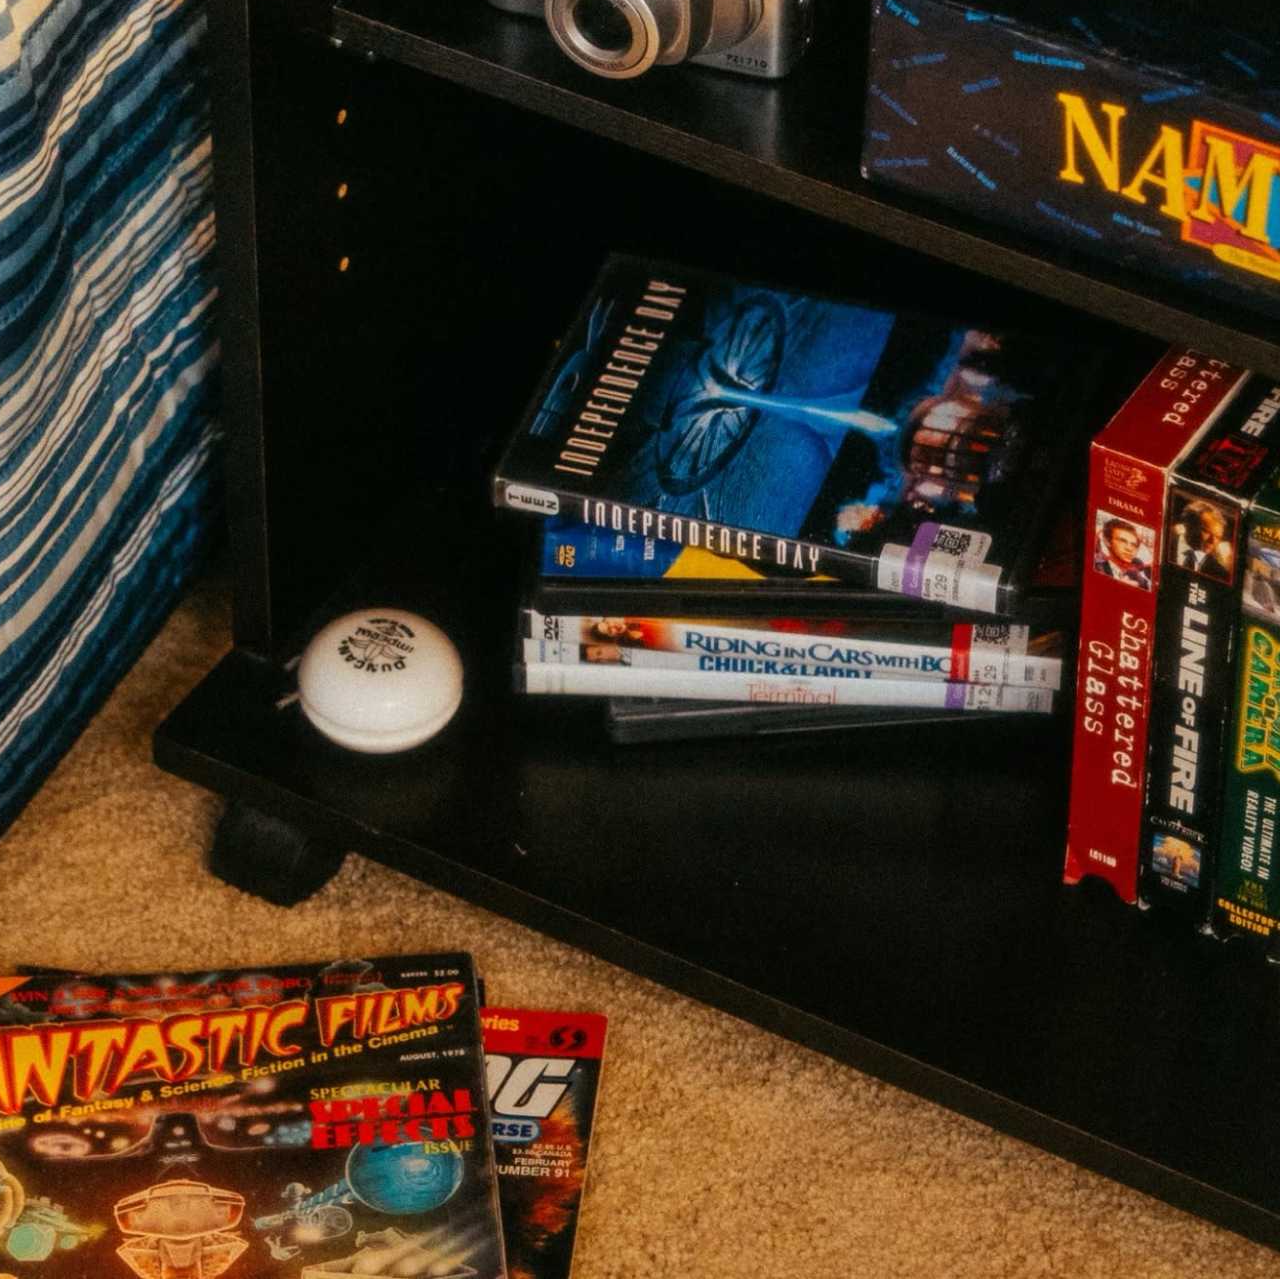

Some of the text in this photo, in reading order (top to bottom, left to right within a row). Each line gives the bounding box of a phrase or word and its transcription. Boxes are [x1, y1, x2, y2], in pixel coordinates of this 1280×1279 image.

[555, 280, 687, 476] INDEPENDENCE DAY
[507, 491, 558, 510] TEEN
[1107, 496, 1145, 518] DRAMA
[583, 498, 762, 561] INDEPENDENCE
[776, 540, 821, 573] DAY
[1187, 582, 1199, 606] THE
[337, 641, 408, 673] DUNCAN
[684, 630, 781, 658] RIDING
[783, 644, 807, 659] IN
[808, 641, 873, 667] CARS
[873, 652, 919, 670] WITH
[1083, 639, 1116, 736] Glass
[1111, 611, 1148, 789] Shattered
[1240, 630, 1274, 769] CAMERA
[1169, 605, 1210, 817] LINE OF FIRE
[1244, 789, 1260, 833] REALITY
[1257, 795, 1278, 881] THE ULTIMATE IN
[1229, 914, 1270, 936] EDITION
[316, 981, 465, 1047] FILMS
[33, 1108, 53, 1124] of
[59, 1094, 135, 1119] Fantasy
[140, 1089, 154, 1103] &
[159, 1074, 236, 1098] Science
[241, 1056, 306, 1081] Fiction
[310, 1047, 329, 1063] in
[332, 1038, 364, 1057] the
[367, 1023, 440, 1050] Cinema
[308, 1077, 442, 1101] SPECTACULAR
[307, 1087, 478, 1123] SPECIAL
[308, 1113, 477, 1151] EFFECTS
[423, 1138, 475, 1156] ISSUE
[495, 1164, 571, 1179] UMBER 91
[513, 1157, 573, 1168] FEBRUARY
